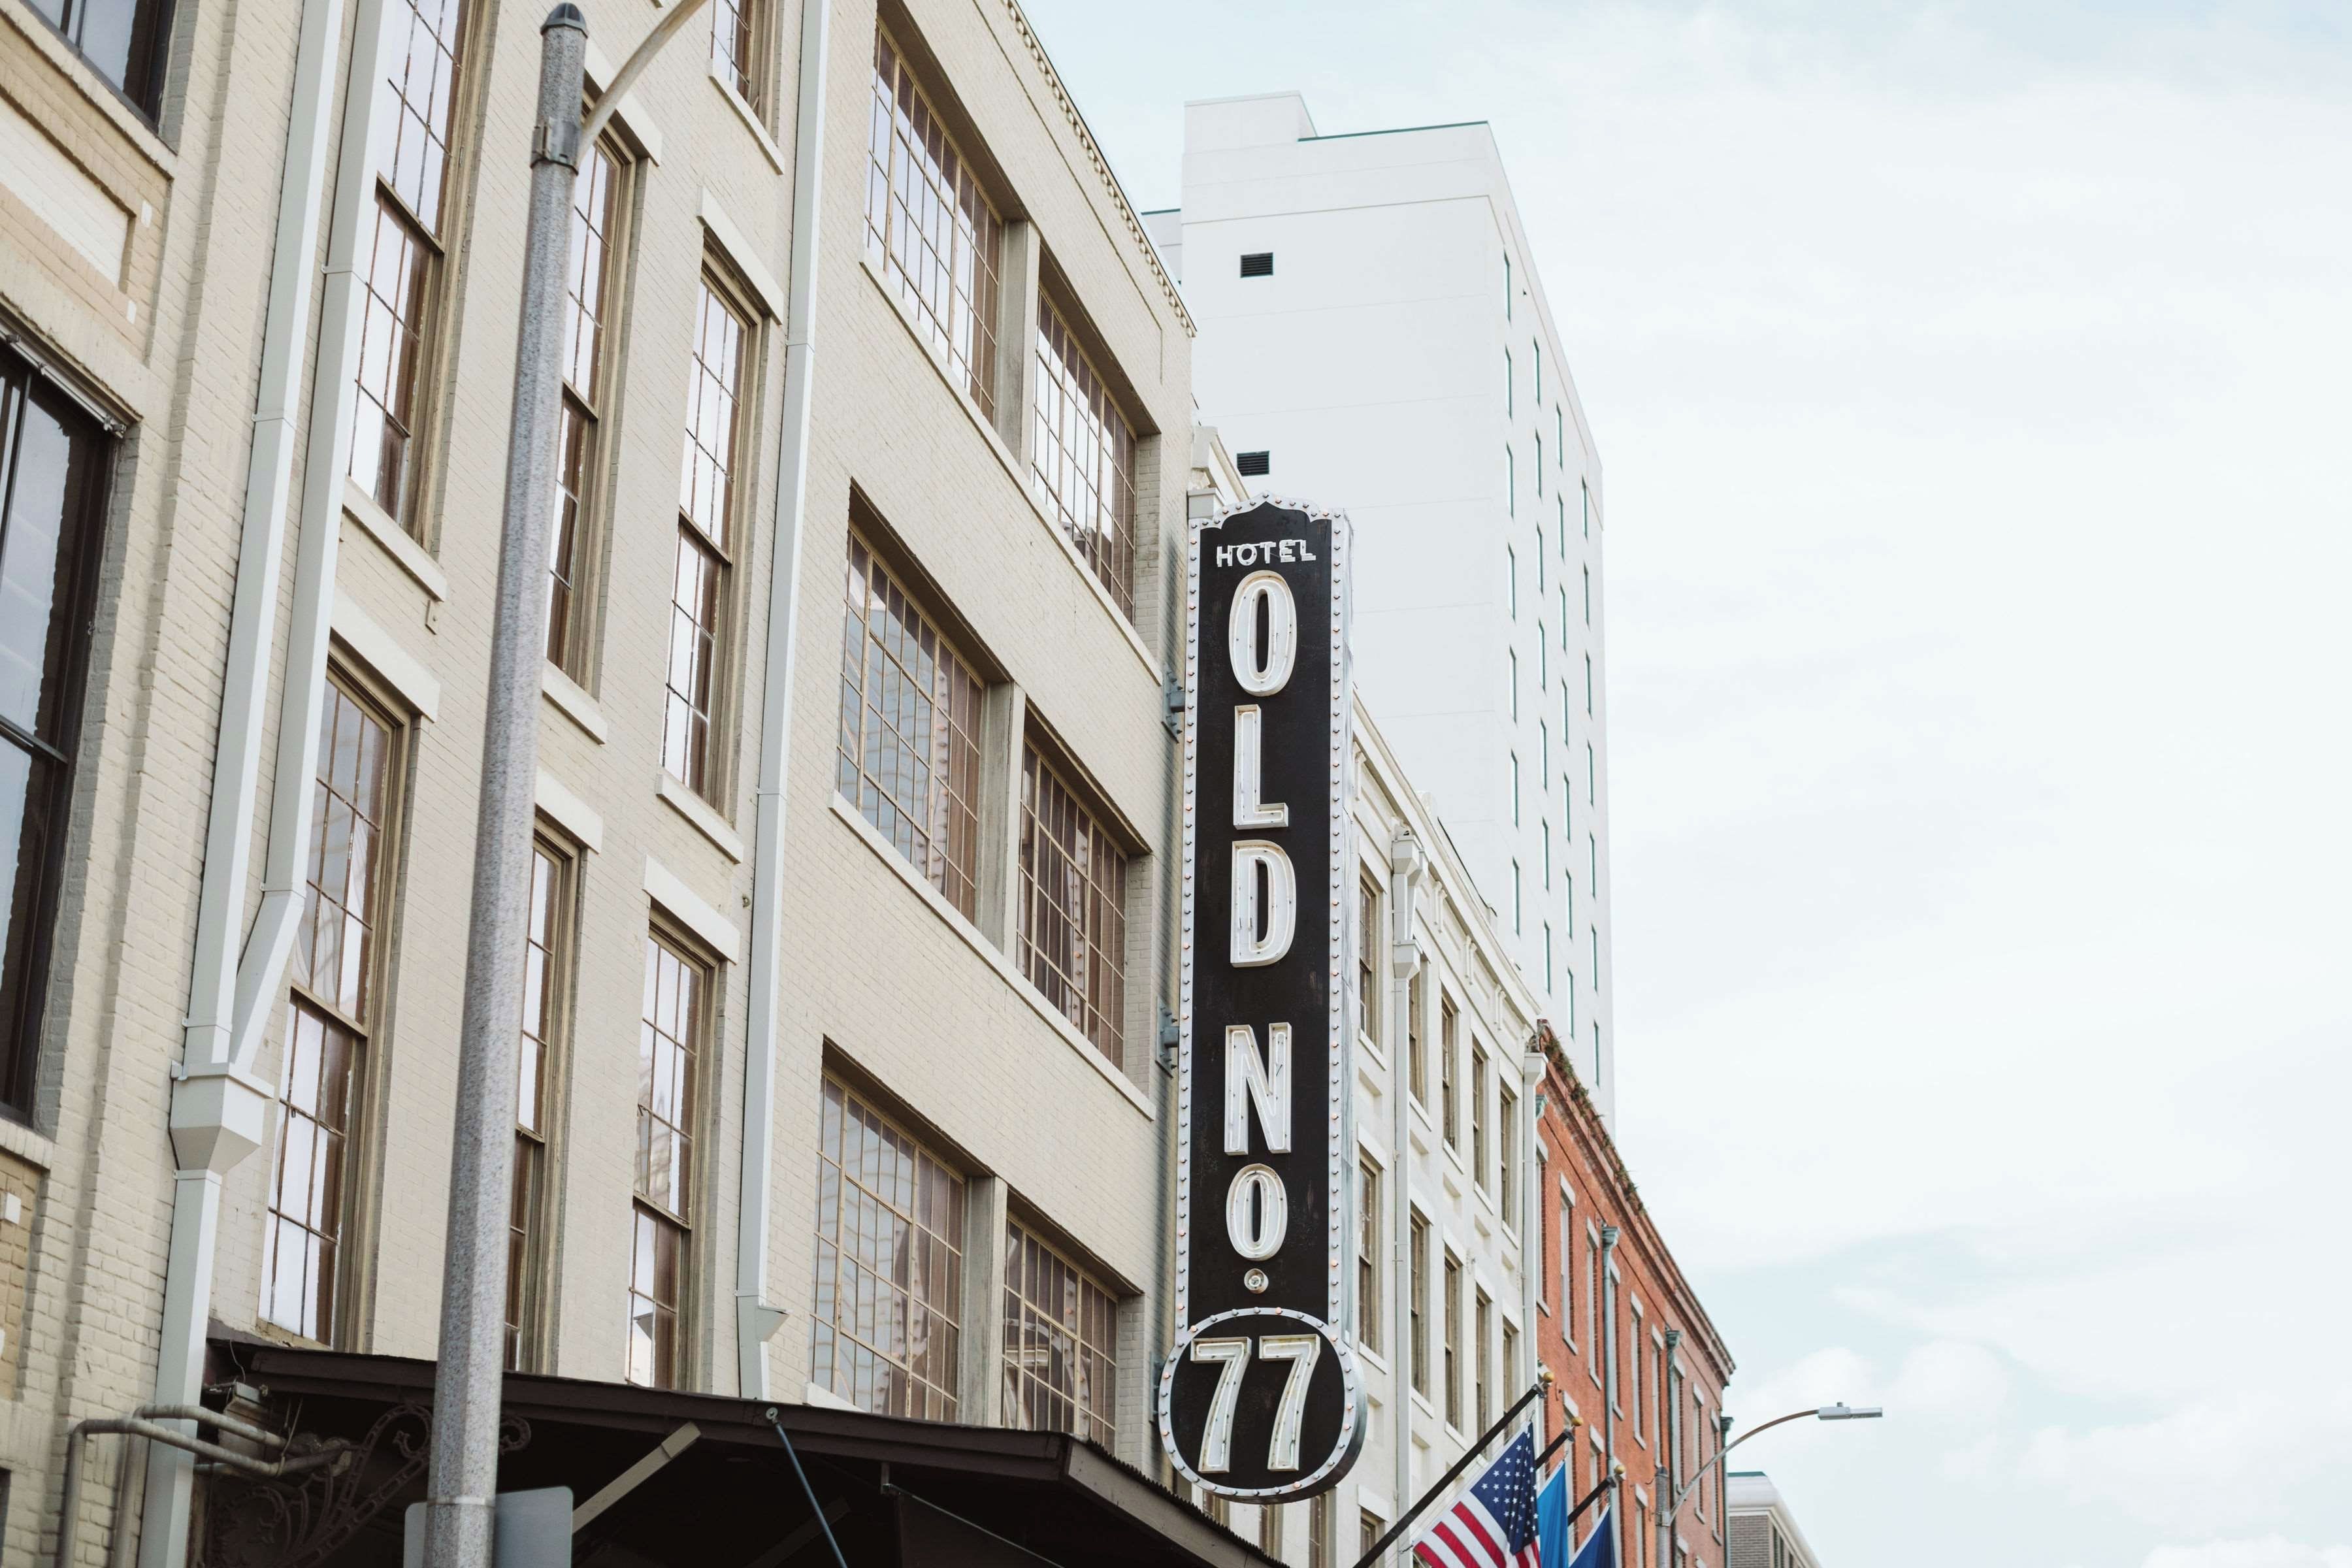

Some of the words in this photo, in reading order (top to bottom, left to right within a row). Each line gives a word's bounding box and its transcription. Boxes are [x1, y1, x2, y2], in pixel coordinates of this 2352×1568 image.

[1217, 540, 1316, 567] HOTEL
[1229, 570, 1297, 968] OLD
[1190, 1333, 1320, 1473] 77
